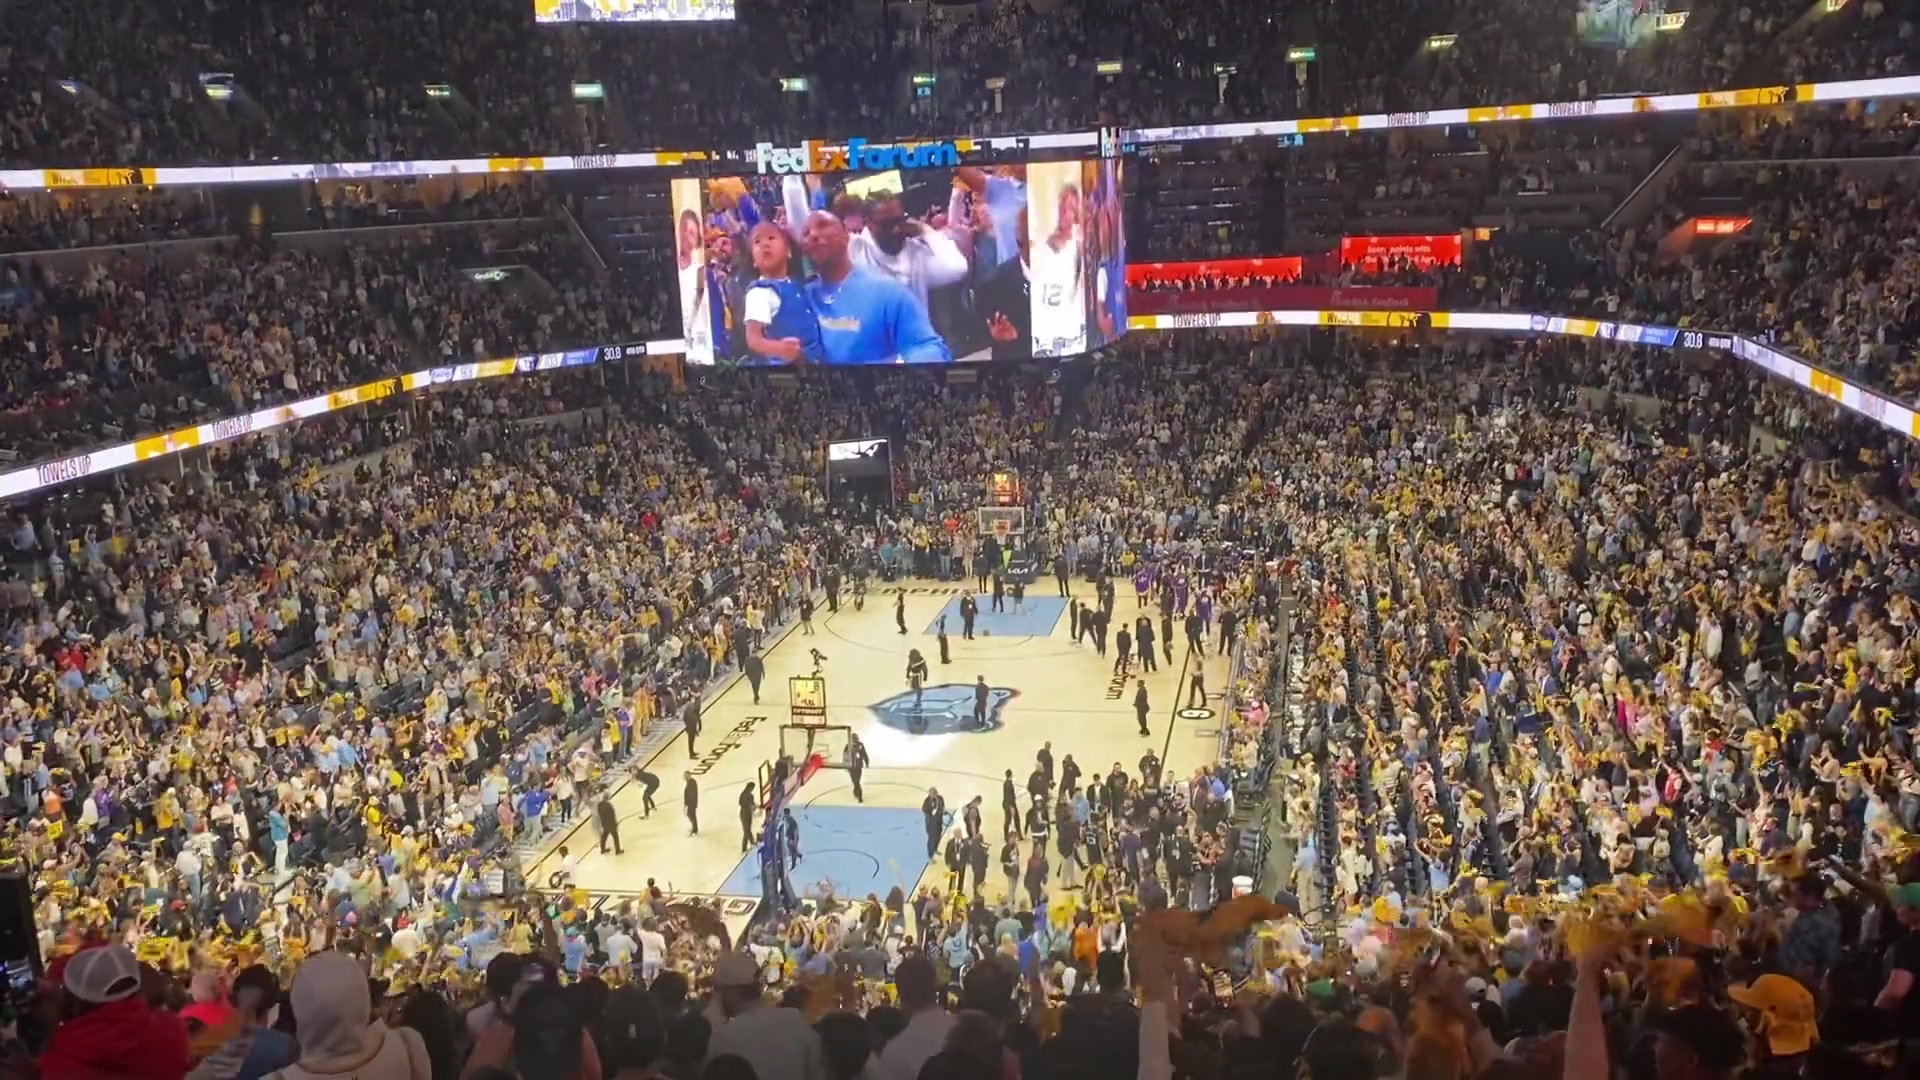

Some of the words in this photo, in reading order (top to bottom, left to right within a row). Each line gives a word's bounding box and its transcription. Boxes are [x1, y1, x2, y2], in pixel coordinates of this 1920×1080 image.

[1586, 100, 1597, 114] UP
[1420, 112, 1430, 124] UP
[755, 138, 957, 174] FedExForum
[1173, 314, 1207, 327] TOWELS
[1209, 313, 1221, 326] UP
[1684, 331, 1703, 349] 30.8
[604, 346, 622, 361] 30.8
[213, 418, 243, 440] TOWELS
[246, 414, 254, 432] UP
[37, 459, 77, 485] TOWELS
[79, 455, 91, 474] UP
